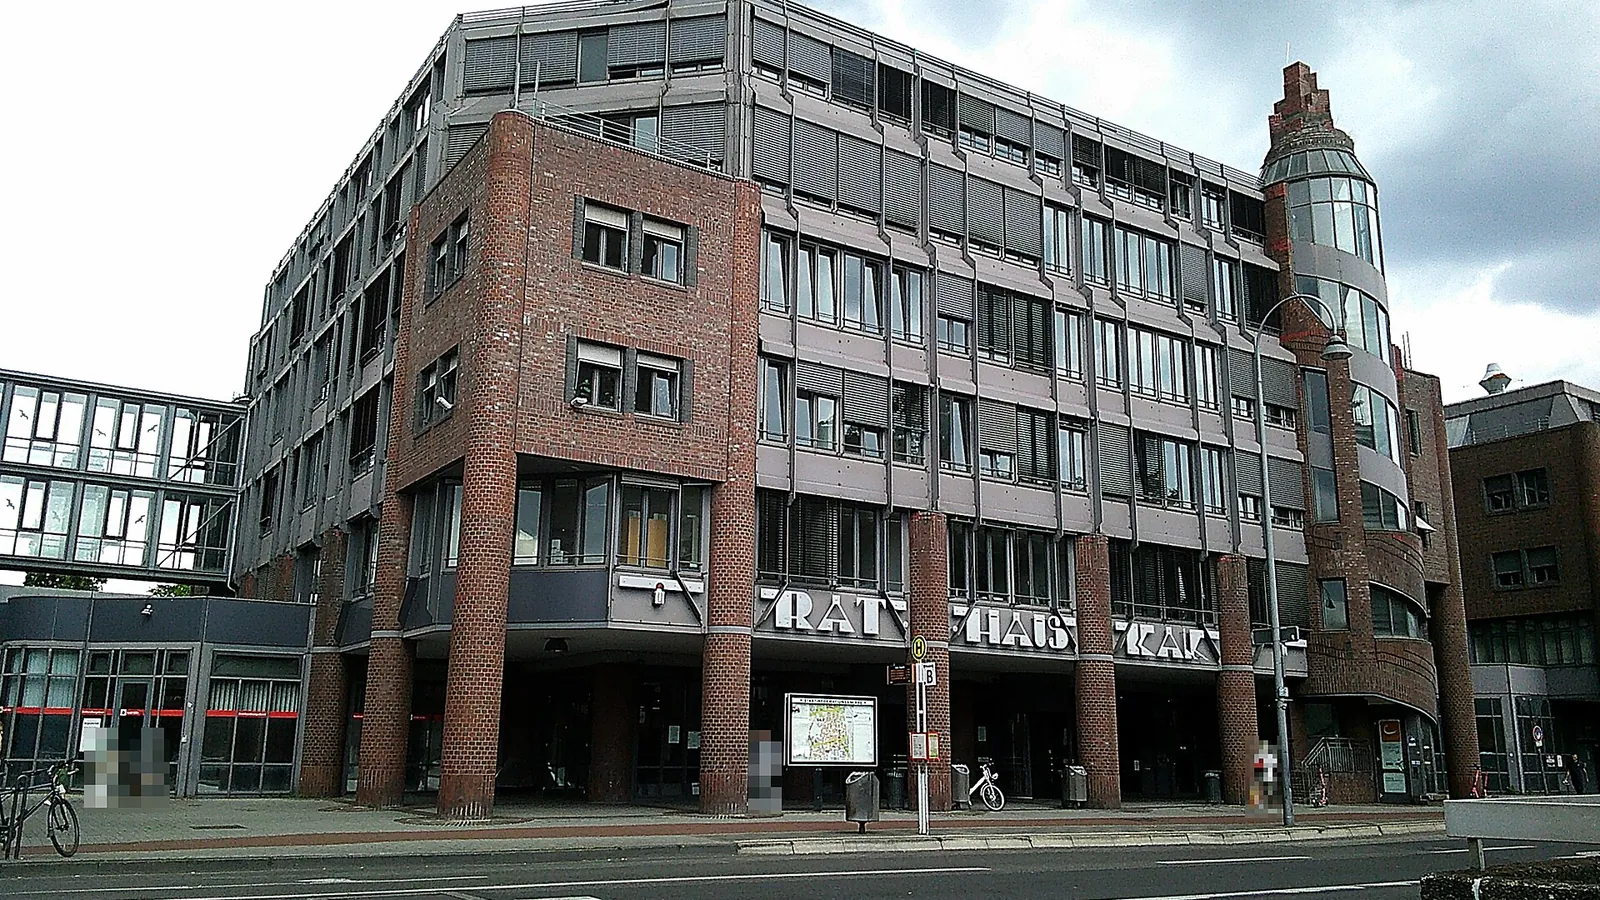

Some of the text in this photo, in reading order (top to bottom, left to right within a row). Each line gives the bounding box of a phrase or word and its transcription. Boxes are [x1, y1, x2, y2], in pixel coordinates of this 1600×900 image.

[775, 589, 887, 635] RAT
[966, 607, 1069, 650] HAUS
[926, 669, 933, 684] B
